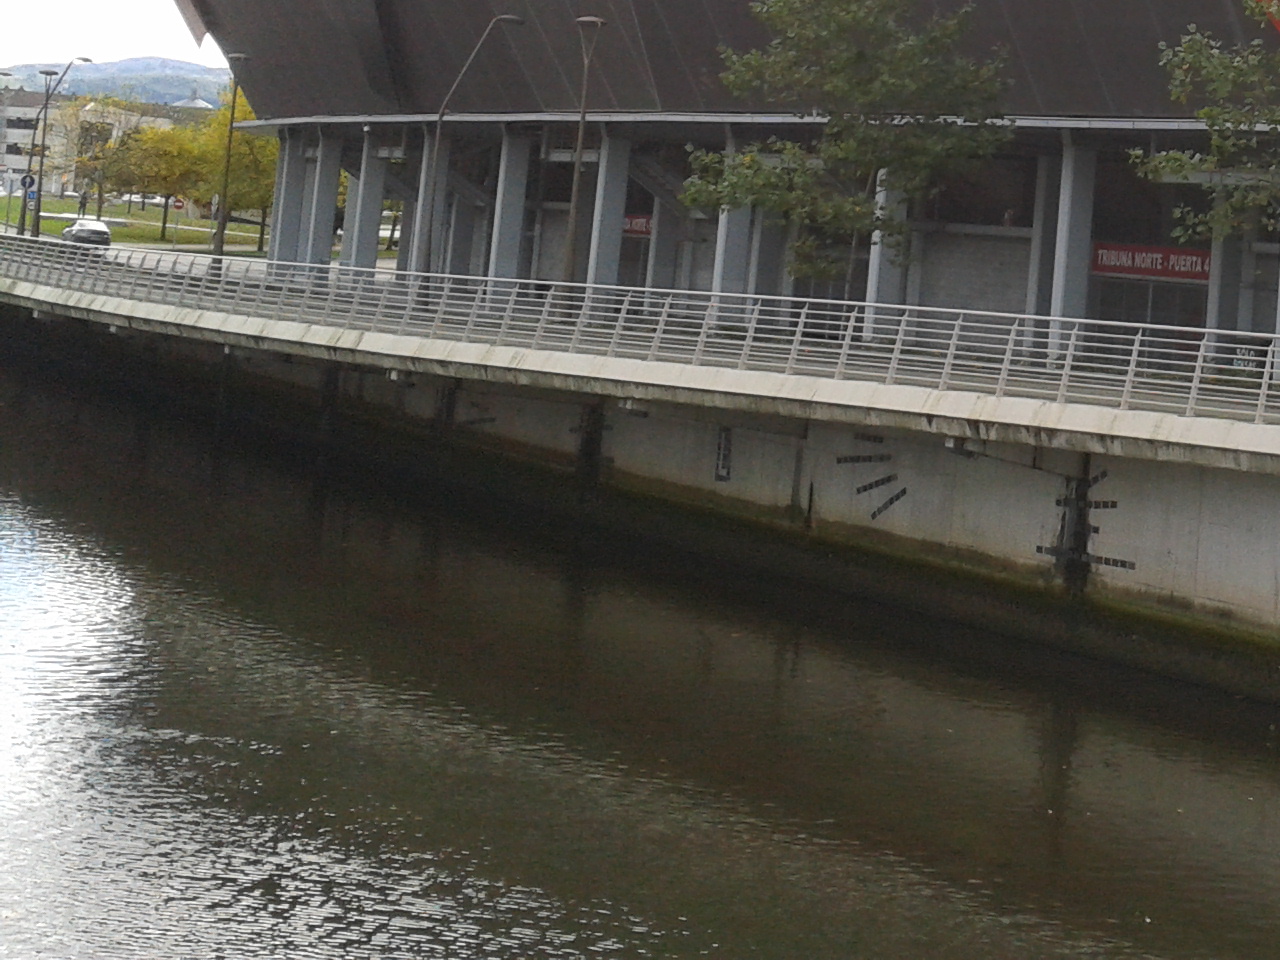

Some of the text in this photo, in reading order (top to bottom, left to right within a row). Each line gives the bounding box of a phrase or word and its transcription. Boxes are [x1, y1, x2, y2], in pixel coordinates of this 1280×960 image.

[1098, 249, 1132, 268] TRIBUNA
[1134, 252, 1163, 270] NORTE
[1168, 254, 1202, 273] PUERTA
